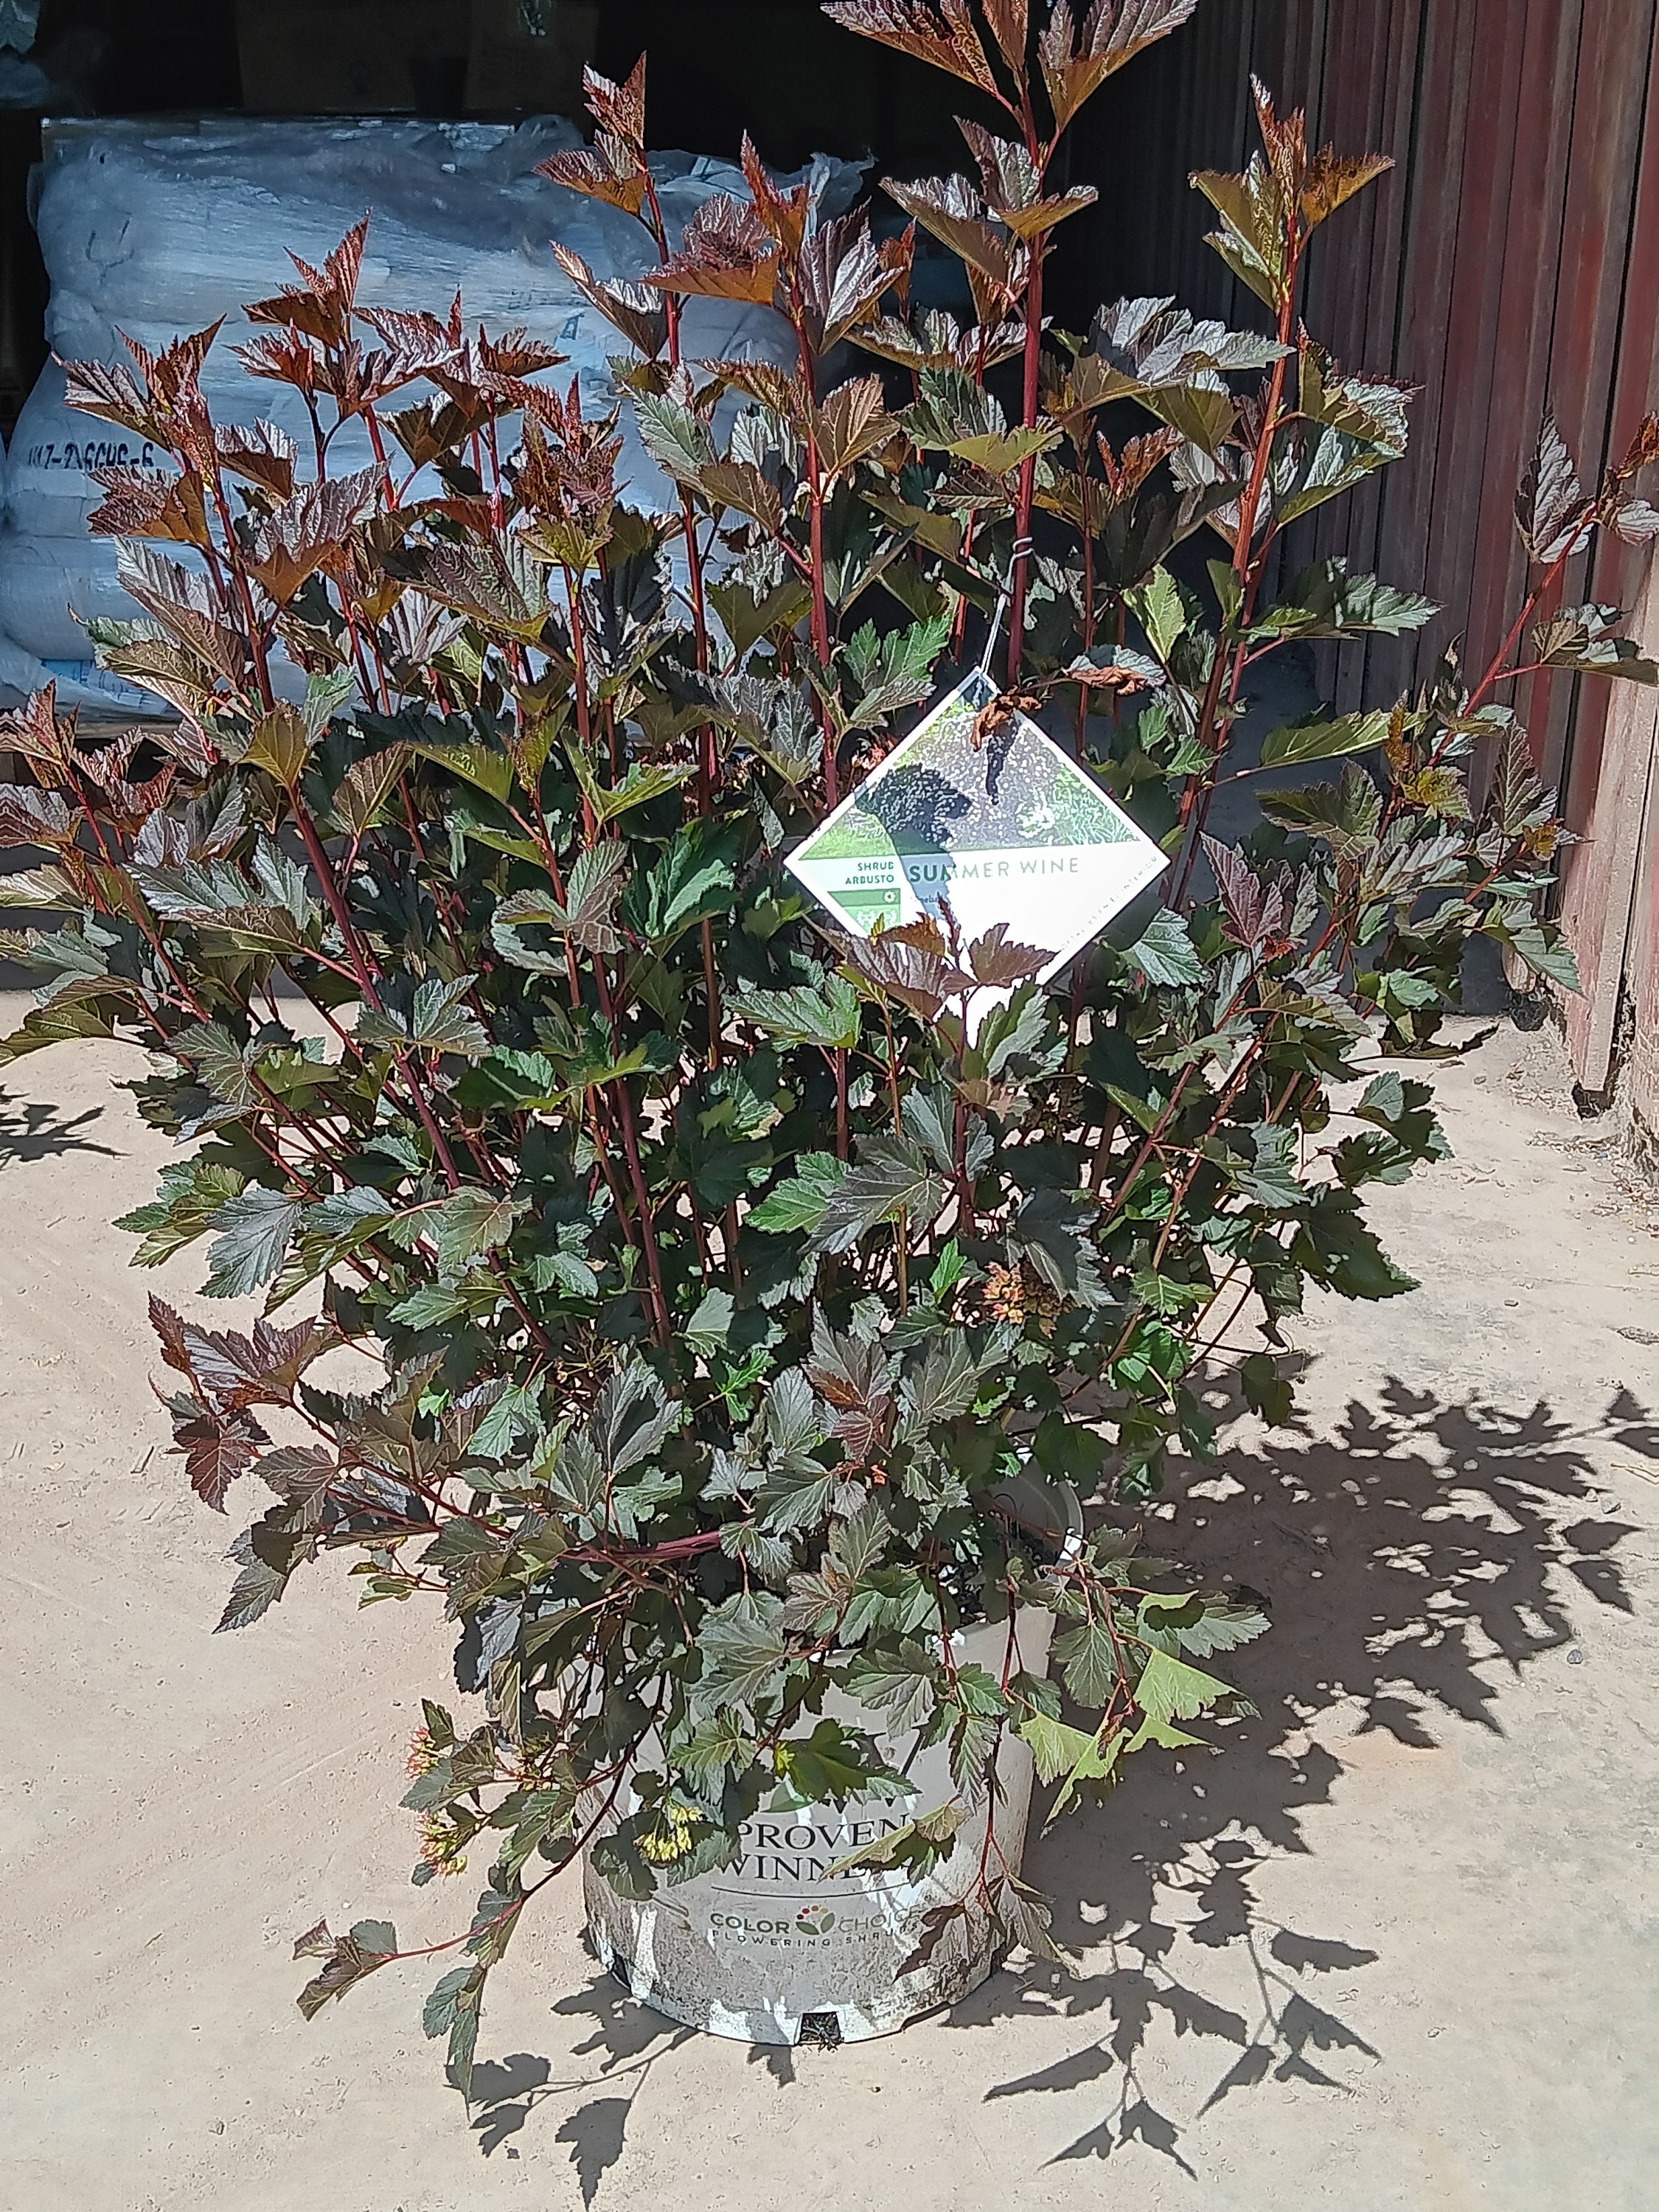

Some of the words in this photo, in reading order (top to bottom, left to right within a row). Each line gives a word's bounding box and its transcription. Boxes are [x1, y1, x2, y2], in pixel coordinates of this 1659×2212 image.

[858, 861, 894, 872] SHRUB
[909, 862, 1010, 883] SUMMER
[1020, 858, 1079, 874] WINE
[845, 874, 894, 885] ARBUSTO
[738, 1812, 910, 1849] PROVEN
[710, 1913, 790, 1934] COLOR
[838, 1905, 920, 1933] CHOICE
[712, 1930, 831, 1947] FLOWERING
